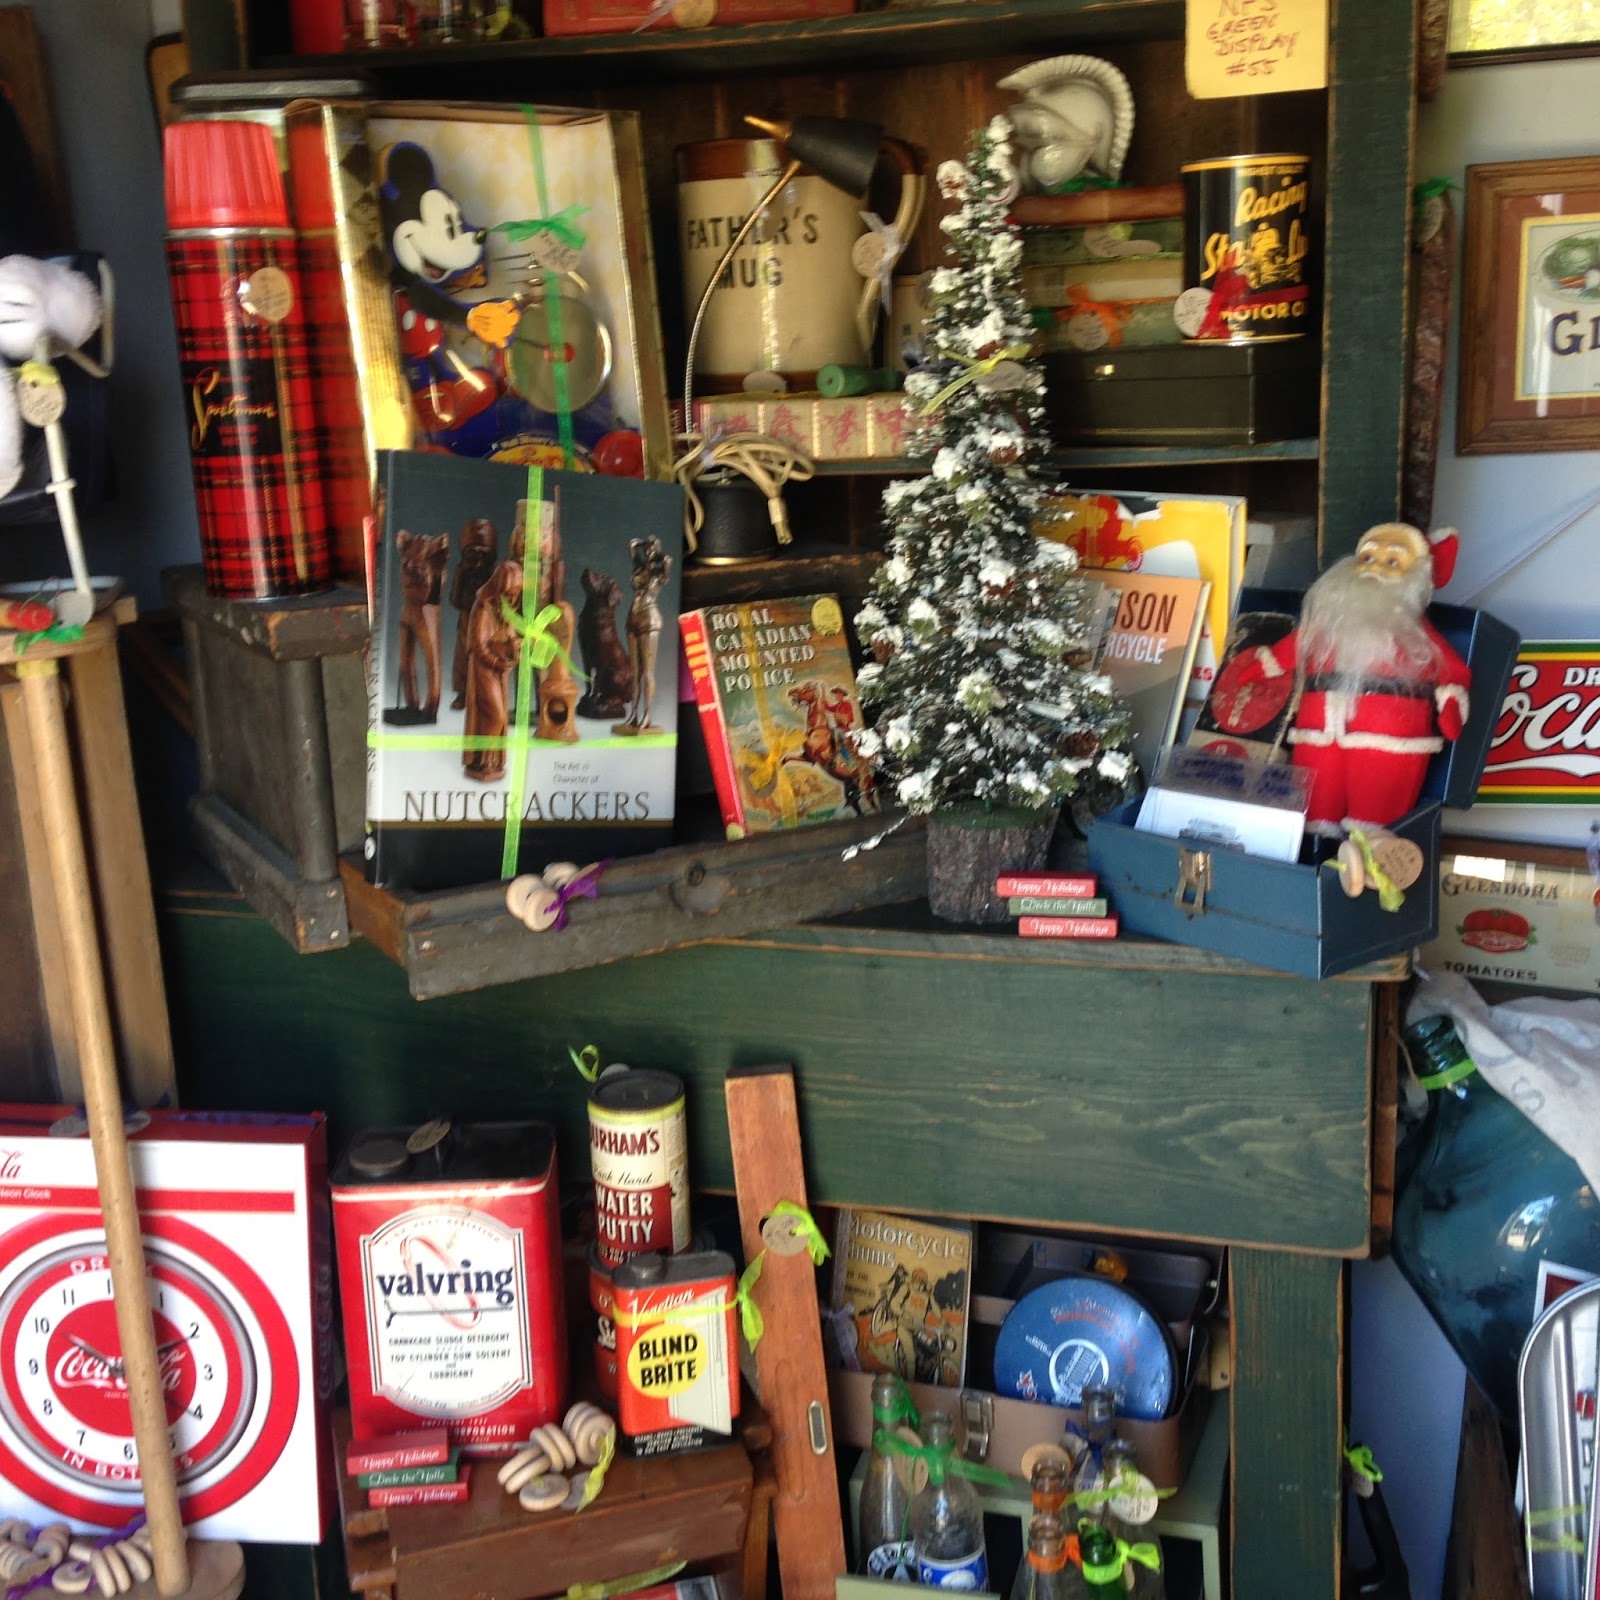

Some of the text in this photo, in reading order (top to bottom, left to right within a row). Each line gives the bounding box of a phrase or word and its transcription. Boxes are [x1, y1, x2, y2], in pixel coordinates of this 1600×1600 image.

[1213, 31, 1300, 58] DISPLAY
[716, 257, 784, 290] MUG
[1444, 960, 1538, 981] TOMATOES
[591, 1125, 660, 1156] URHAM'S
[595, 1183, 654, 1218] WATER
[598, 1210, 654, 1245] PUTTY
[376, 1259, 515, 1310] valvring
[639, 1334, 698, 1361] BLIND
[641, 1359, 697, 1389] BRITE
[452, 1424, 516, 1438] ORPORATION
